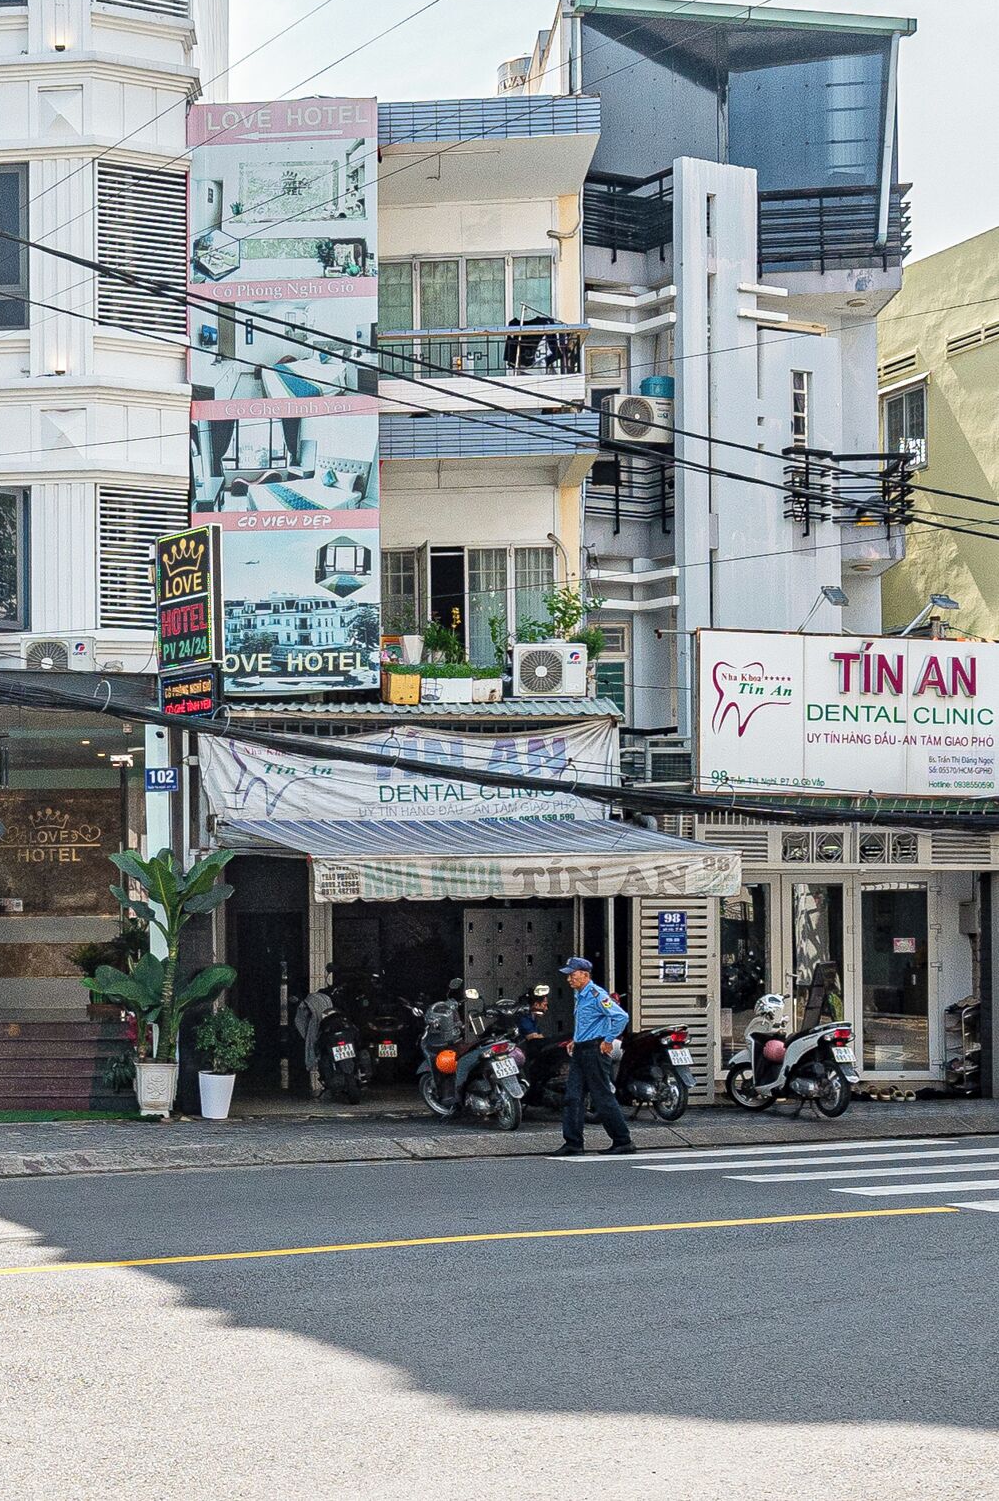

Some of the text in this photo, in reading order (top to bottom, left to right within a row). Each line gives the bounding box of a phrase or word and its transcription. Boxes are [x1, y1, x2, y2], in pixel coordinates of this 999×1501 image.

[207, 105, 369, 131] LOVE HOTEL
[237, 513, 258, 527] CÓ
[262, 515, 298, 527] VIEW
[165, 572, 202, 598] LOVE
[161, 602, 207, 638] HOTEL
[163, 636, 208, 661] PV 24/24
[221, 652, 369, 673] OVE HOTEL
[830, 642, 977, 697] TÍN AN
[721, 673, 762, 682] Nha Khoa
[738, 682, 793, 697] Tín An
[806, 704, 994, 726] DENTAL CLINIC
[807, 733, 822, 744] UY
[824, 731, 840, 745] TÍN
[842, 732, 871, 745] HÀNG
[902, 735, 917, 746] AN
[945, 736, 969, 747] GIAO
[971, 734, 994, 748] PHÓ
[148, 770, 174, 784] 102
[711, 770, 728, 784] 98
[379, 784, 472, 803] DENTAL
[30, 830, 69, 843] LOVE
[18, 848, 81, 862] HOTEL
[512, 858, 601, 894] TÍN
[618, 865, 689, 894] AN
[664, 913, 681, 923] 98
